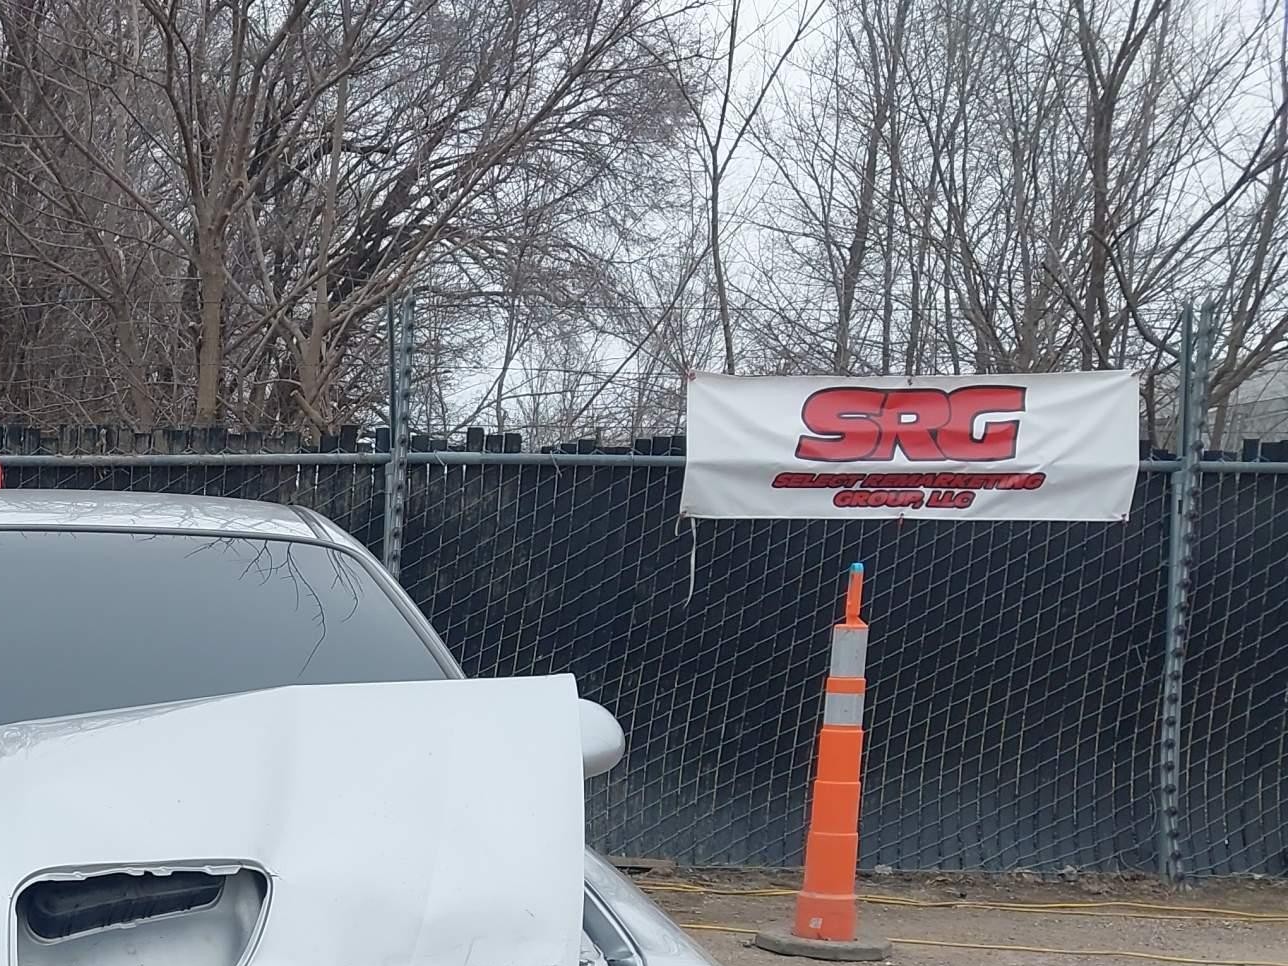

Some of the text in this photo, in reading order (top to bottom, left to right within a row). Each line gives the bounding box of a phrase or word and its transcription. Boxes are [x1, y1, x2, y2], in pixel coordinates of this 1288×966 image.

[795, 385, 1027, 461] SRG
[772, 472, 1046, 490] SELECT REMARKETING
[833, 490, 976, 509] GROUP, LLC
